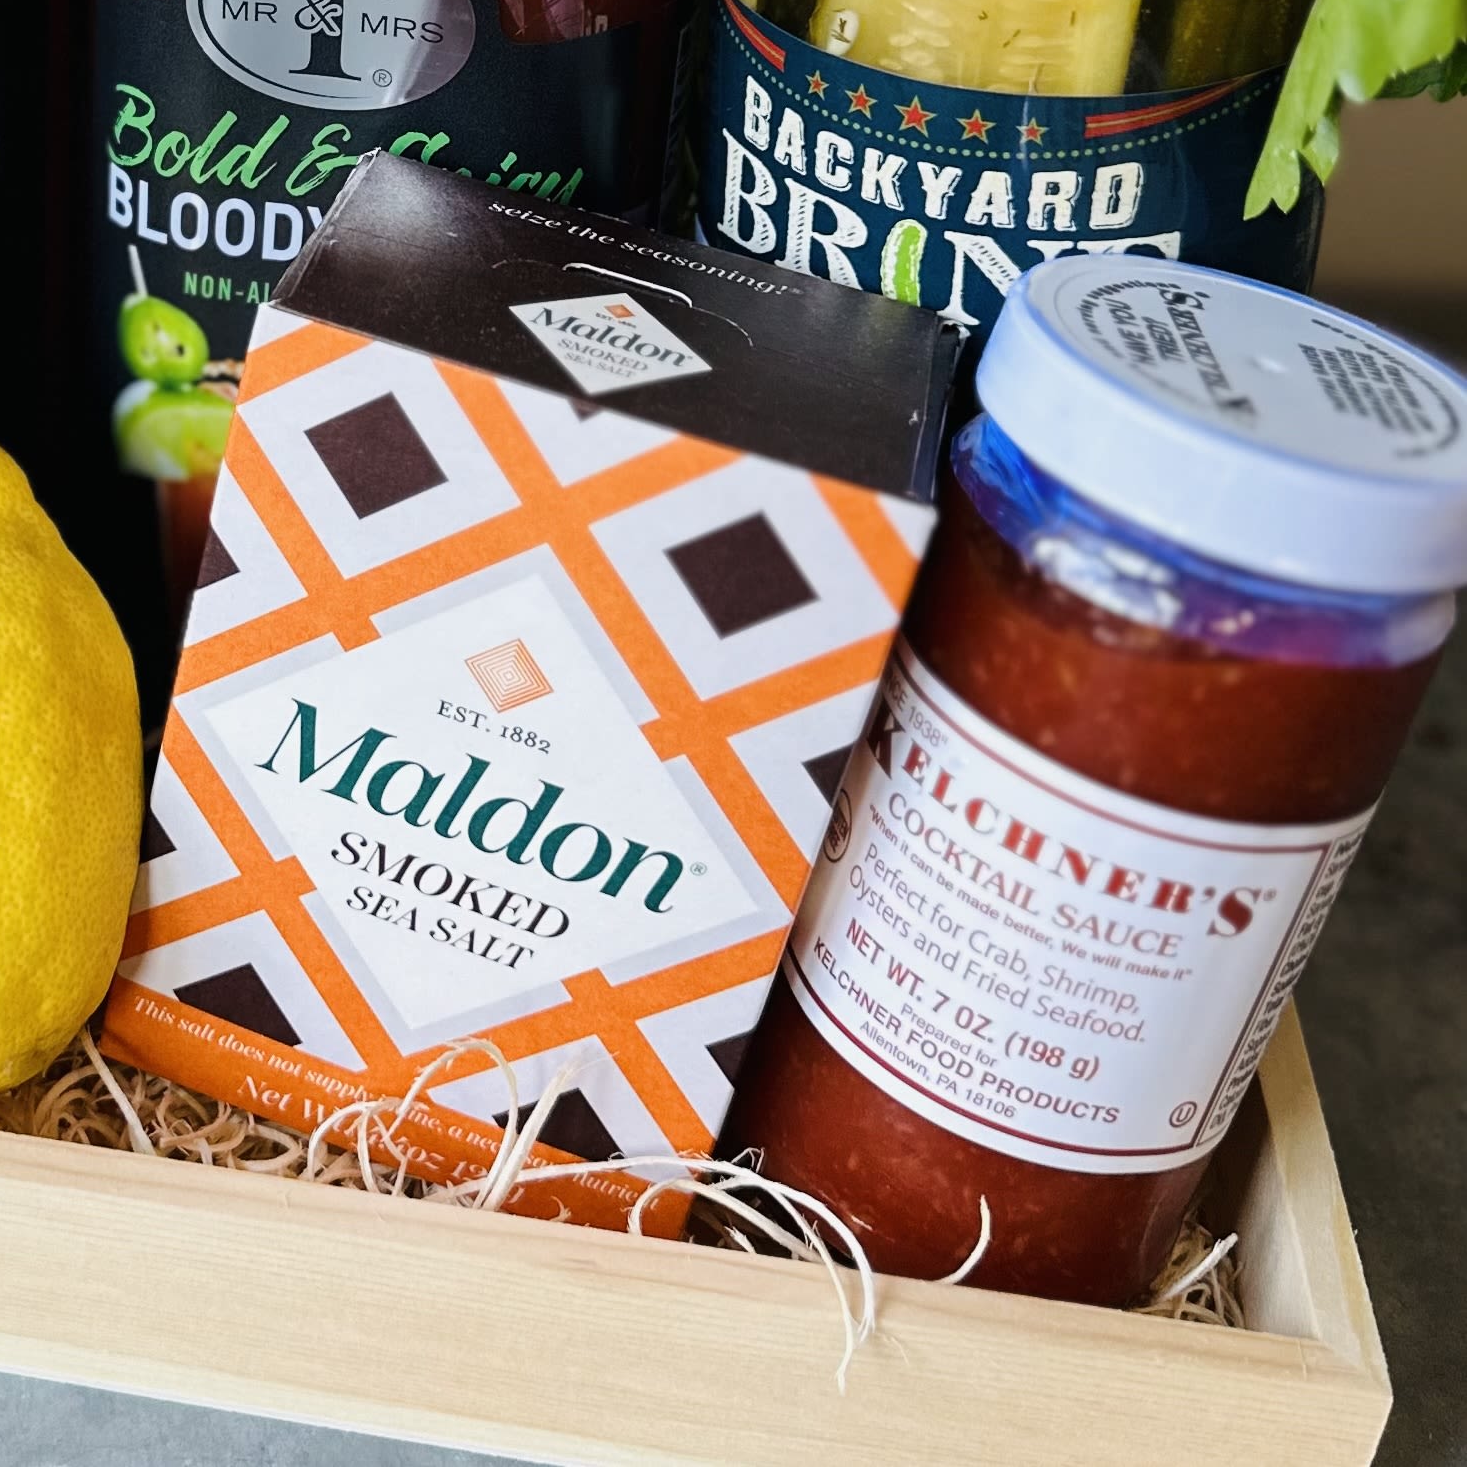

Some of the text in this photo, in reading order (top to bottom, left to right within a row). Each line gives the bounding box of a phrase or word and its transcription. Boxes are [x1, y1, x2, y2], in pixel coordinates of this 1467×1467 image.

[221, 0, 278, 24] MR
[360, 13, 444, 44] MRS
[107, 83, 290, 191] Bold
[291, 123, 363, 197] &
[744, 74, 1145, 231] BACKYARD
[488, 201, 792, 295] seize the seasoning!
[529, 307, 689, 367] Maldon
[558, 338, 649, 371] SMOKED
[564, 352, 636, 378] SEA SALT
[436, 699, 551, 755] EST. 1882
[330, 831, 570, 940] SMOKED
[889, 791, 1040, 917] COCKTAIL
[1050, 901, 1184, 959] SAUCE
[345, 885, 535, 971] SEA SALT
[849, 865, 1146, 1044] Oysters and Fried Seafood.
[863, 843, 1141, 1015] Perfect for Crab, Shrimp,
[135, 995, 176, 1025] This
[178, 1019, 216, 1043] salt
[218, 1033, 266, 1063] does
[268, 1055, 303, 1078] not
[813, 936, 1120, 1125] KELCHNER FOOD PRODUCTS
[845, 918, 1101, 1082] NET WT. 7 OZ. (198 g)
[899, 1003, 998, 1068] Prepared for
[237, 1075, 293, 1112] Net
[858, 1019, 1018, 1120] Allentown, PA 18106
